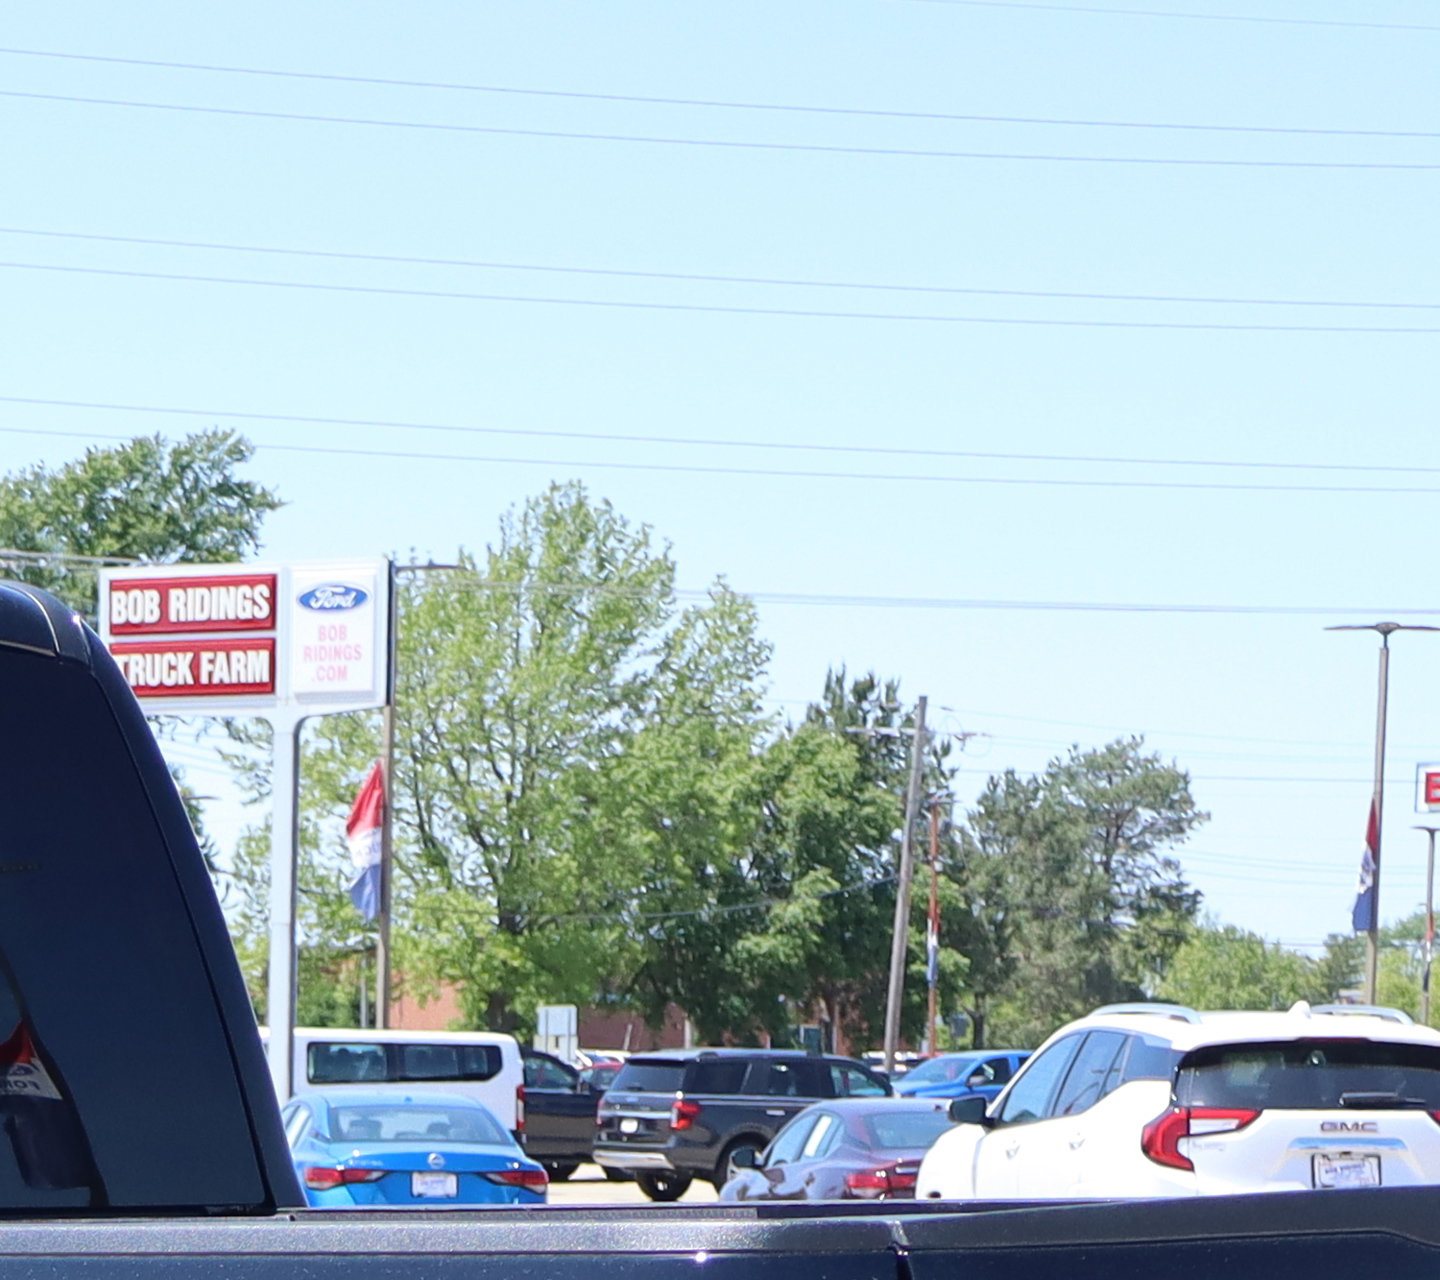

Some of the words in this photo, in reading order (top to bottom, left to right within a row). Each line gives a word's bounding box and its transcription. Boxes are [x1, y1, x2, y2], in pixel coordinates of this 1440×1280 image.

[111, 589, 161, 625] BOB
[169, 584, 271, 623] RIDINGS
[309, 585, 357, 608] Ford
[318, 624, 347, 642] BOB
[303, 644, 362, 661] RIDINGS
[115, 652, 195, 687] TRUCK
[199, 650, 271, 684] FARM
[1320, 1121, 1378, 1132] GMC
